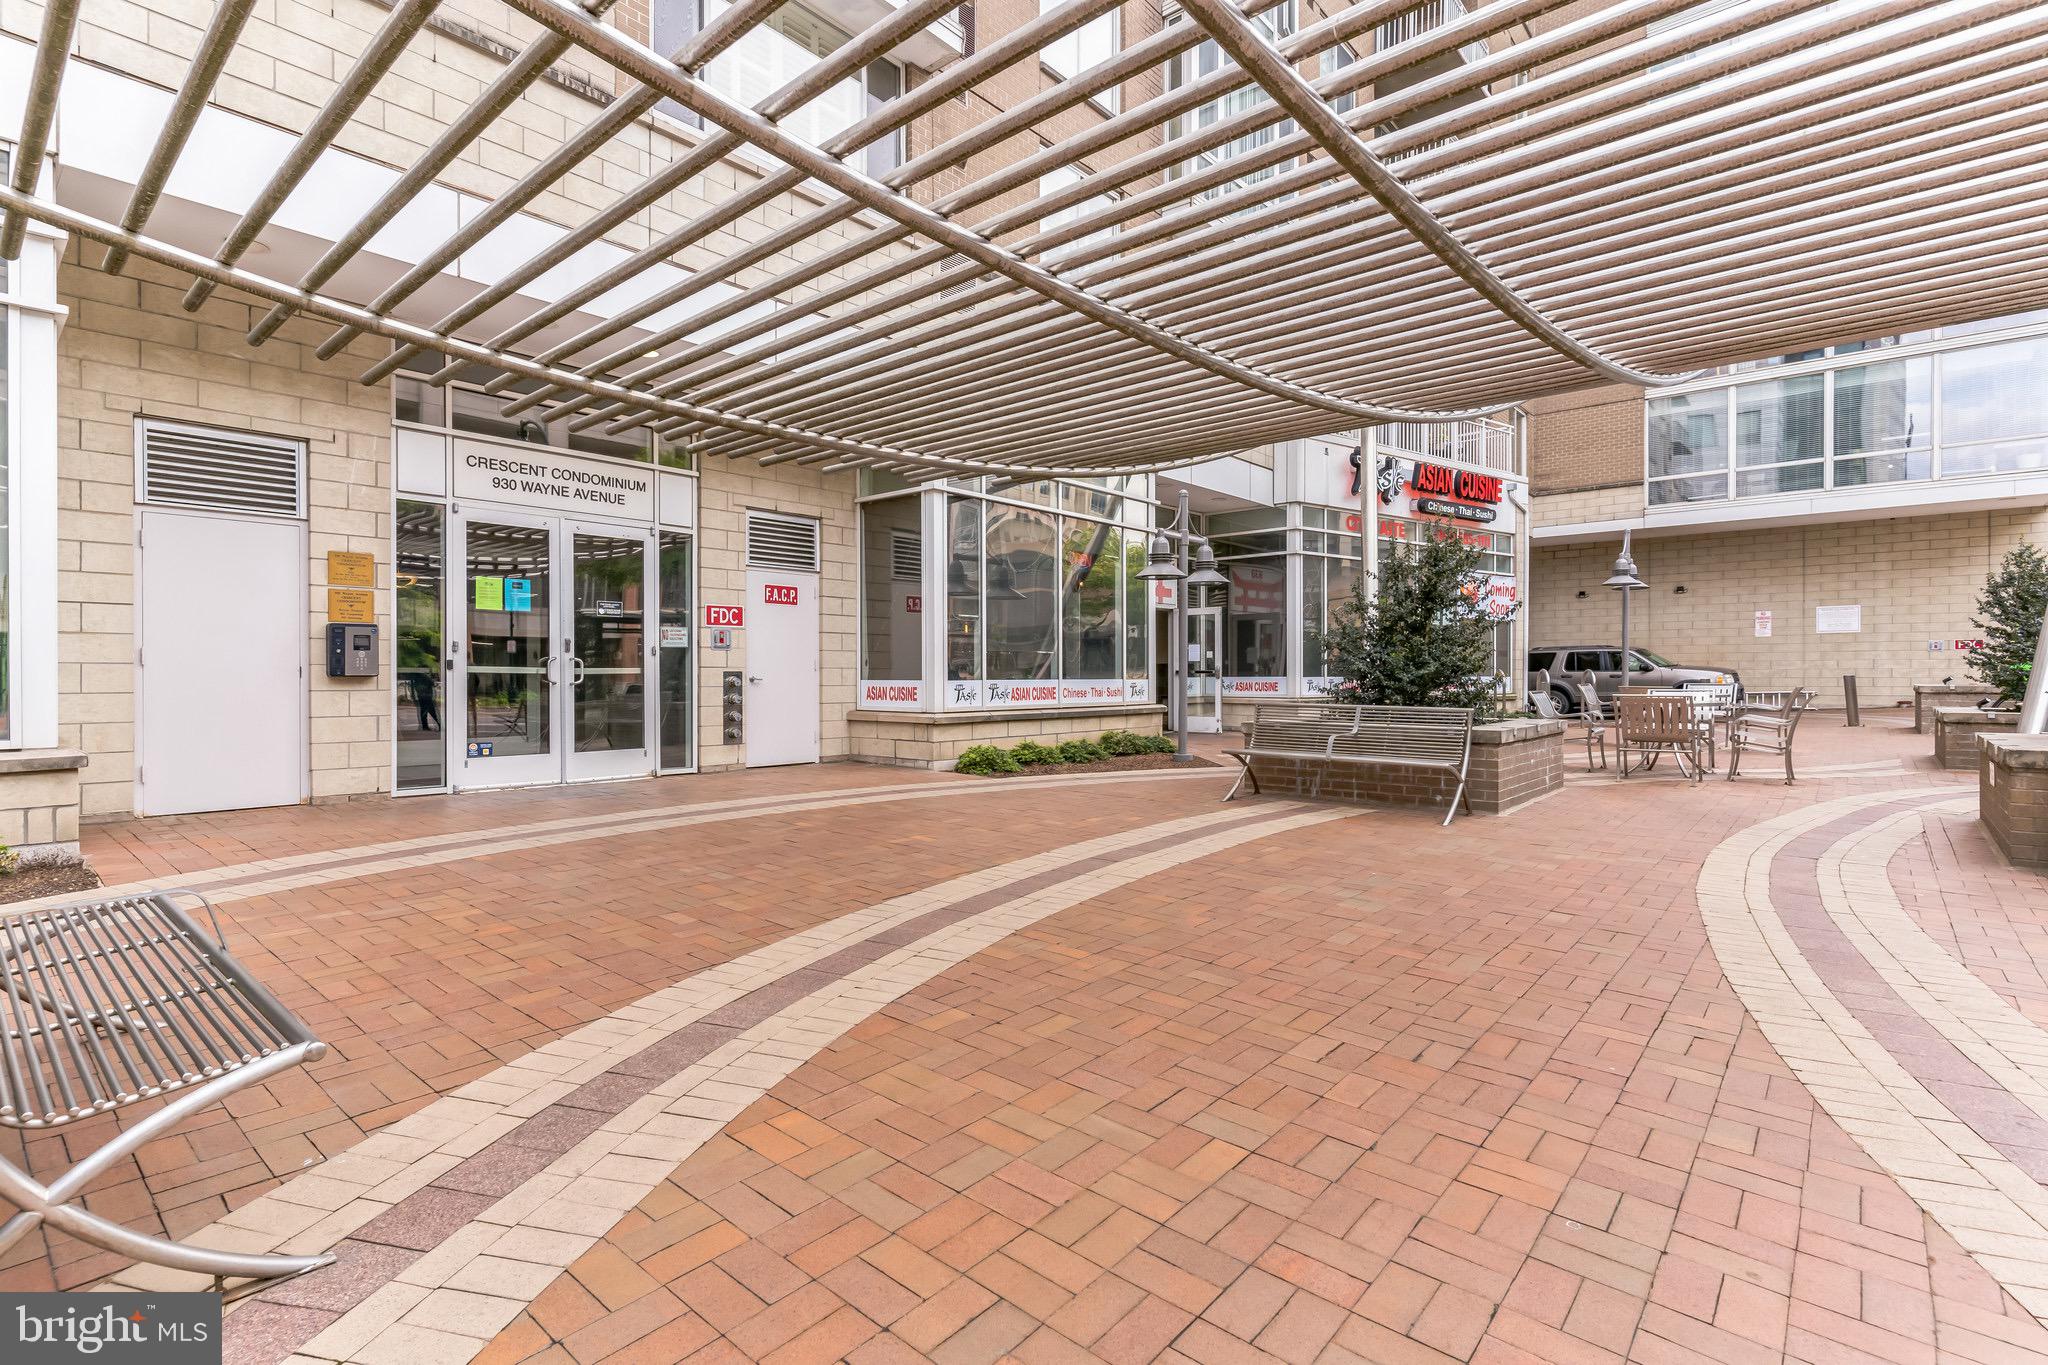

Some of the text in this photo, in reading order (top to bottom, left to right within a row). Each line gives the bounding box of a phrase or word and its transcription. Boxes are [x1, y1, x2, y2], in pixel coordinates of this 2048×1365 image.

[466, 455, 646, 492] CRESCENT CONDOMINIUM
[1416, 463, 1503, 502] ASIAN CUISINE
[492, 476, 626, 506] 930 WAYNE AVENUE
[1458, 506, 1473, 516] Thai
[1475, 508, 1494, 519] Sushi
[765, 587, 797, 603] F.A.C.P.
[710, 607, 739, 625] FDC
[866, 685, 918, 702] ASIAN CUISINE
[1011, 687, 1031, 701] ASIAN
[1031, 686, 1057, 701] CUISINE
[1062, 686, 1123, 699] Chinese Thai Sushi
[1235, 680, 1253, 692] ASIAN
[1254, 681, 1279, 692] CUISINE
